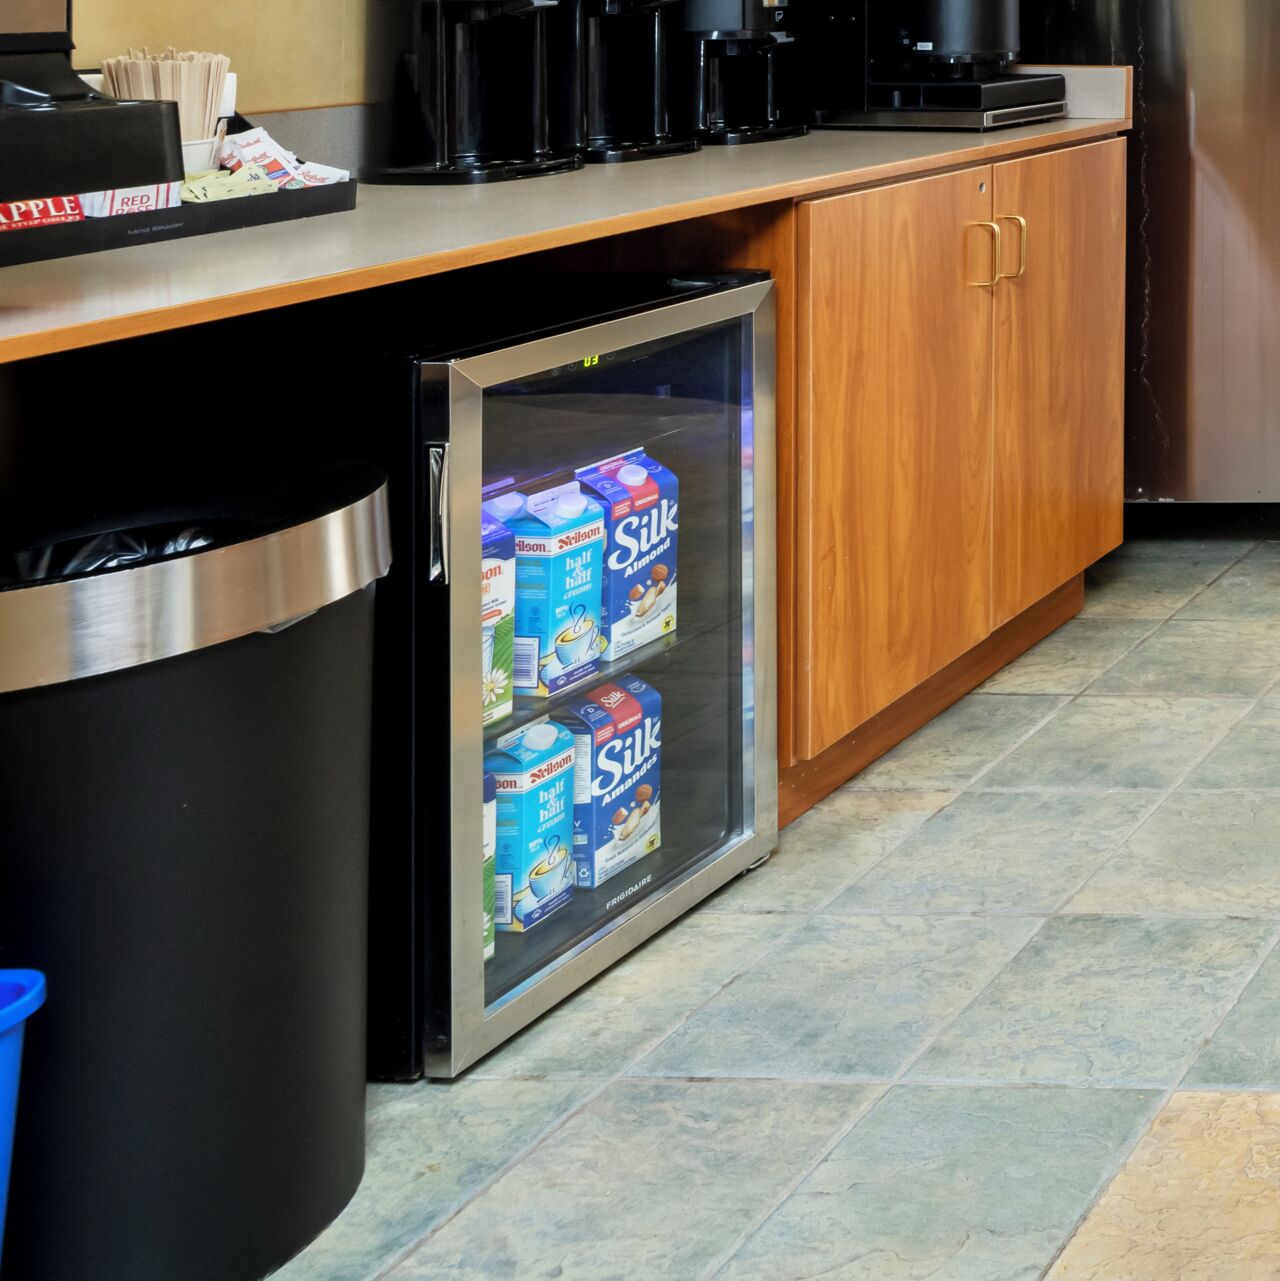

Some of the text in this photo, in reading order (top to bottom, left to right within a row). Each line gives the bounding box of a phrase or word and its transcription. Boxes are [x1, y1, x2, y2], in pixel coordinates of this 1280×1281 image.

[120, 194, 150, 207] RED
[634, 493, 659, 507] ORIGINAL
[515, 540, 547, 553] eilson
[558, 525, 601, 550] Neilson
[607, 499, 679, 570] Silk
[565, 549, 593, 571] half
[624, 536, 671, 578] Almond
[565, 568, 593, 590] half
[601, 690, 626, 707] Silk
[530, 754, 573, 784] Neilson
[591, 717, 662, 797] Silk
[539, 778, 566, 803] half
[602, 753, 659, 808] Amandes
[539, 796, 566, 823] half
[606, 874, 653, 911] FRIGIDAIRE
